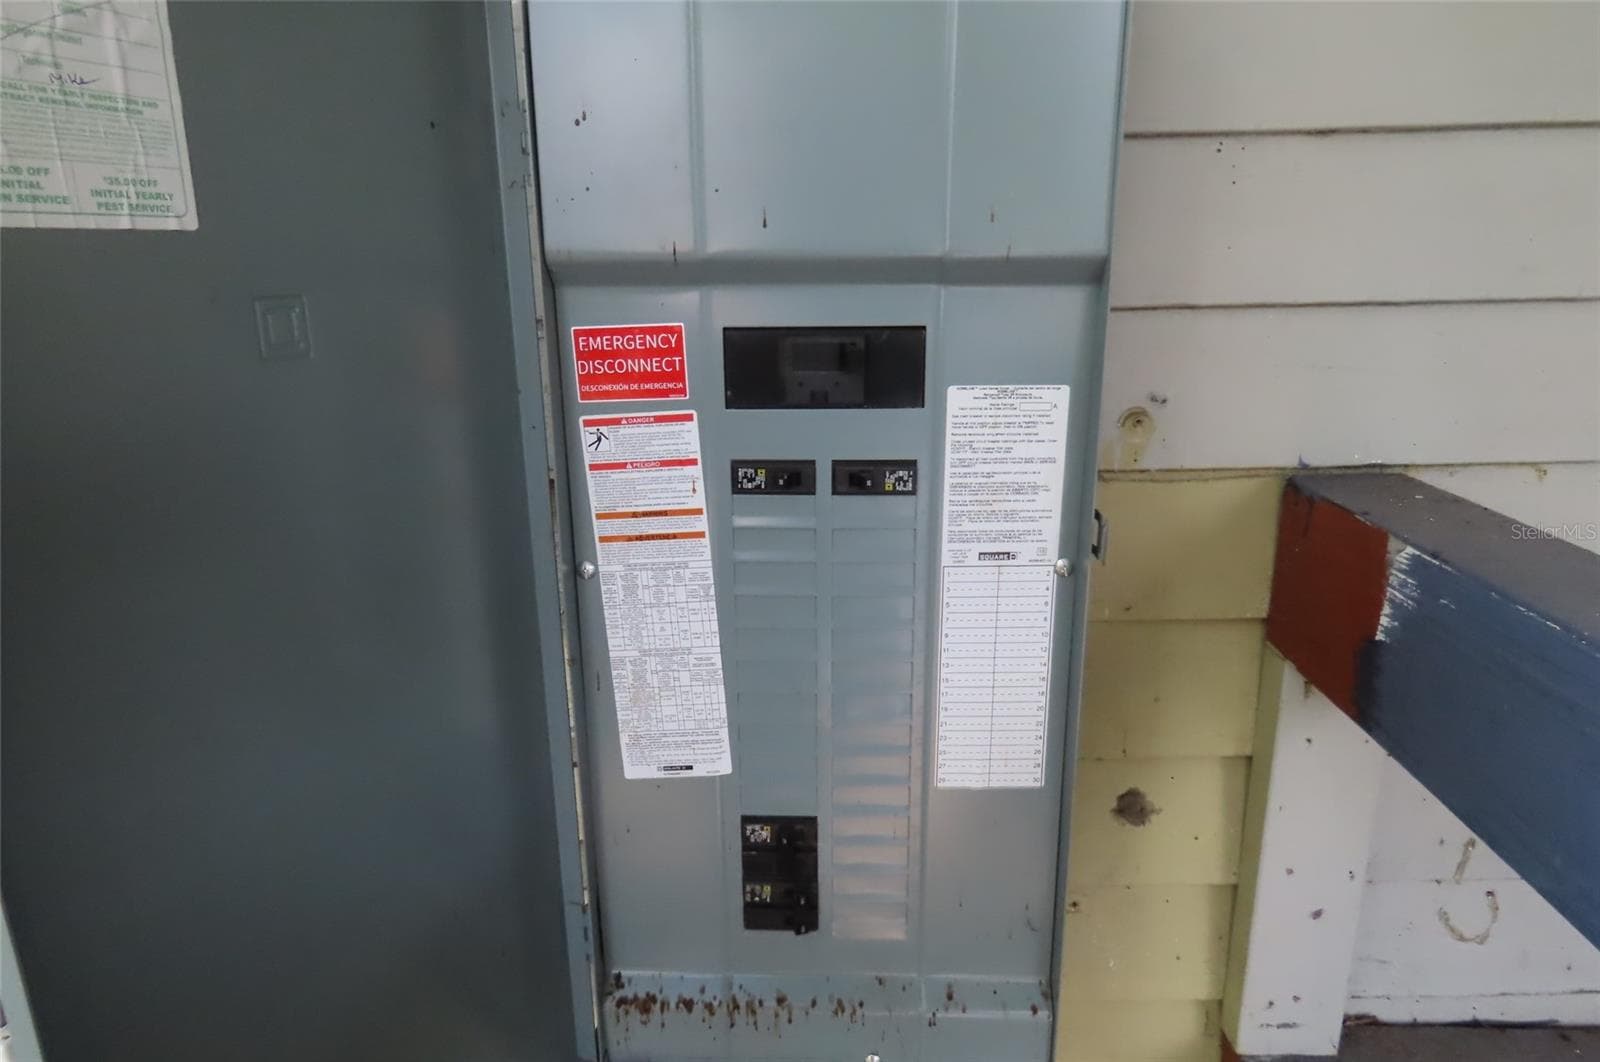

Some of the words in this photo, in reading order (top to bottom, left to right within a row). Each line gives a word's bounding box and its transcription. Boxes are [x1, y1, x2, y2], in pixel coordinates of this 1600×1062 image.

[27, 166, 50, 177] OFF
[15, 194, 72, 205] SERVICE
[90, 188, 131, 200] INITIAL
[134, 191, 174, 202] YEARLY
[96, 202, 125, 212] PEST
[578, 333, 678, 352] EMERGENCY
[577, 356, 683, 375] DISCONNECT
[581, 381, 629, 392] DESCONEXIÓN
[630, 383, 640, 391] DE
[640, 382, 684, 391] EMERGENCIA
[628, 416, 655, 424] DANGER
[632, 461, 661, 469] PELIGRO
